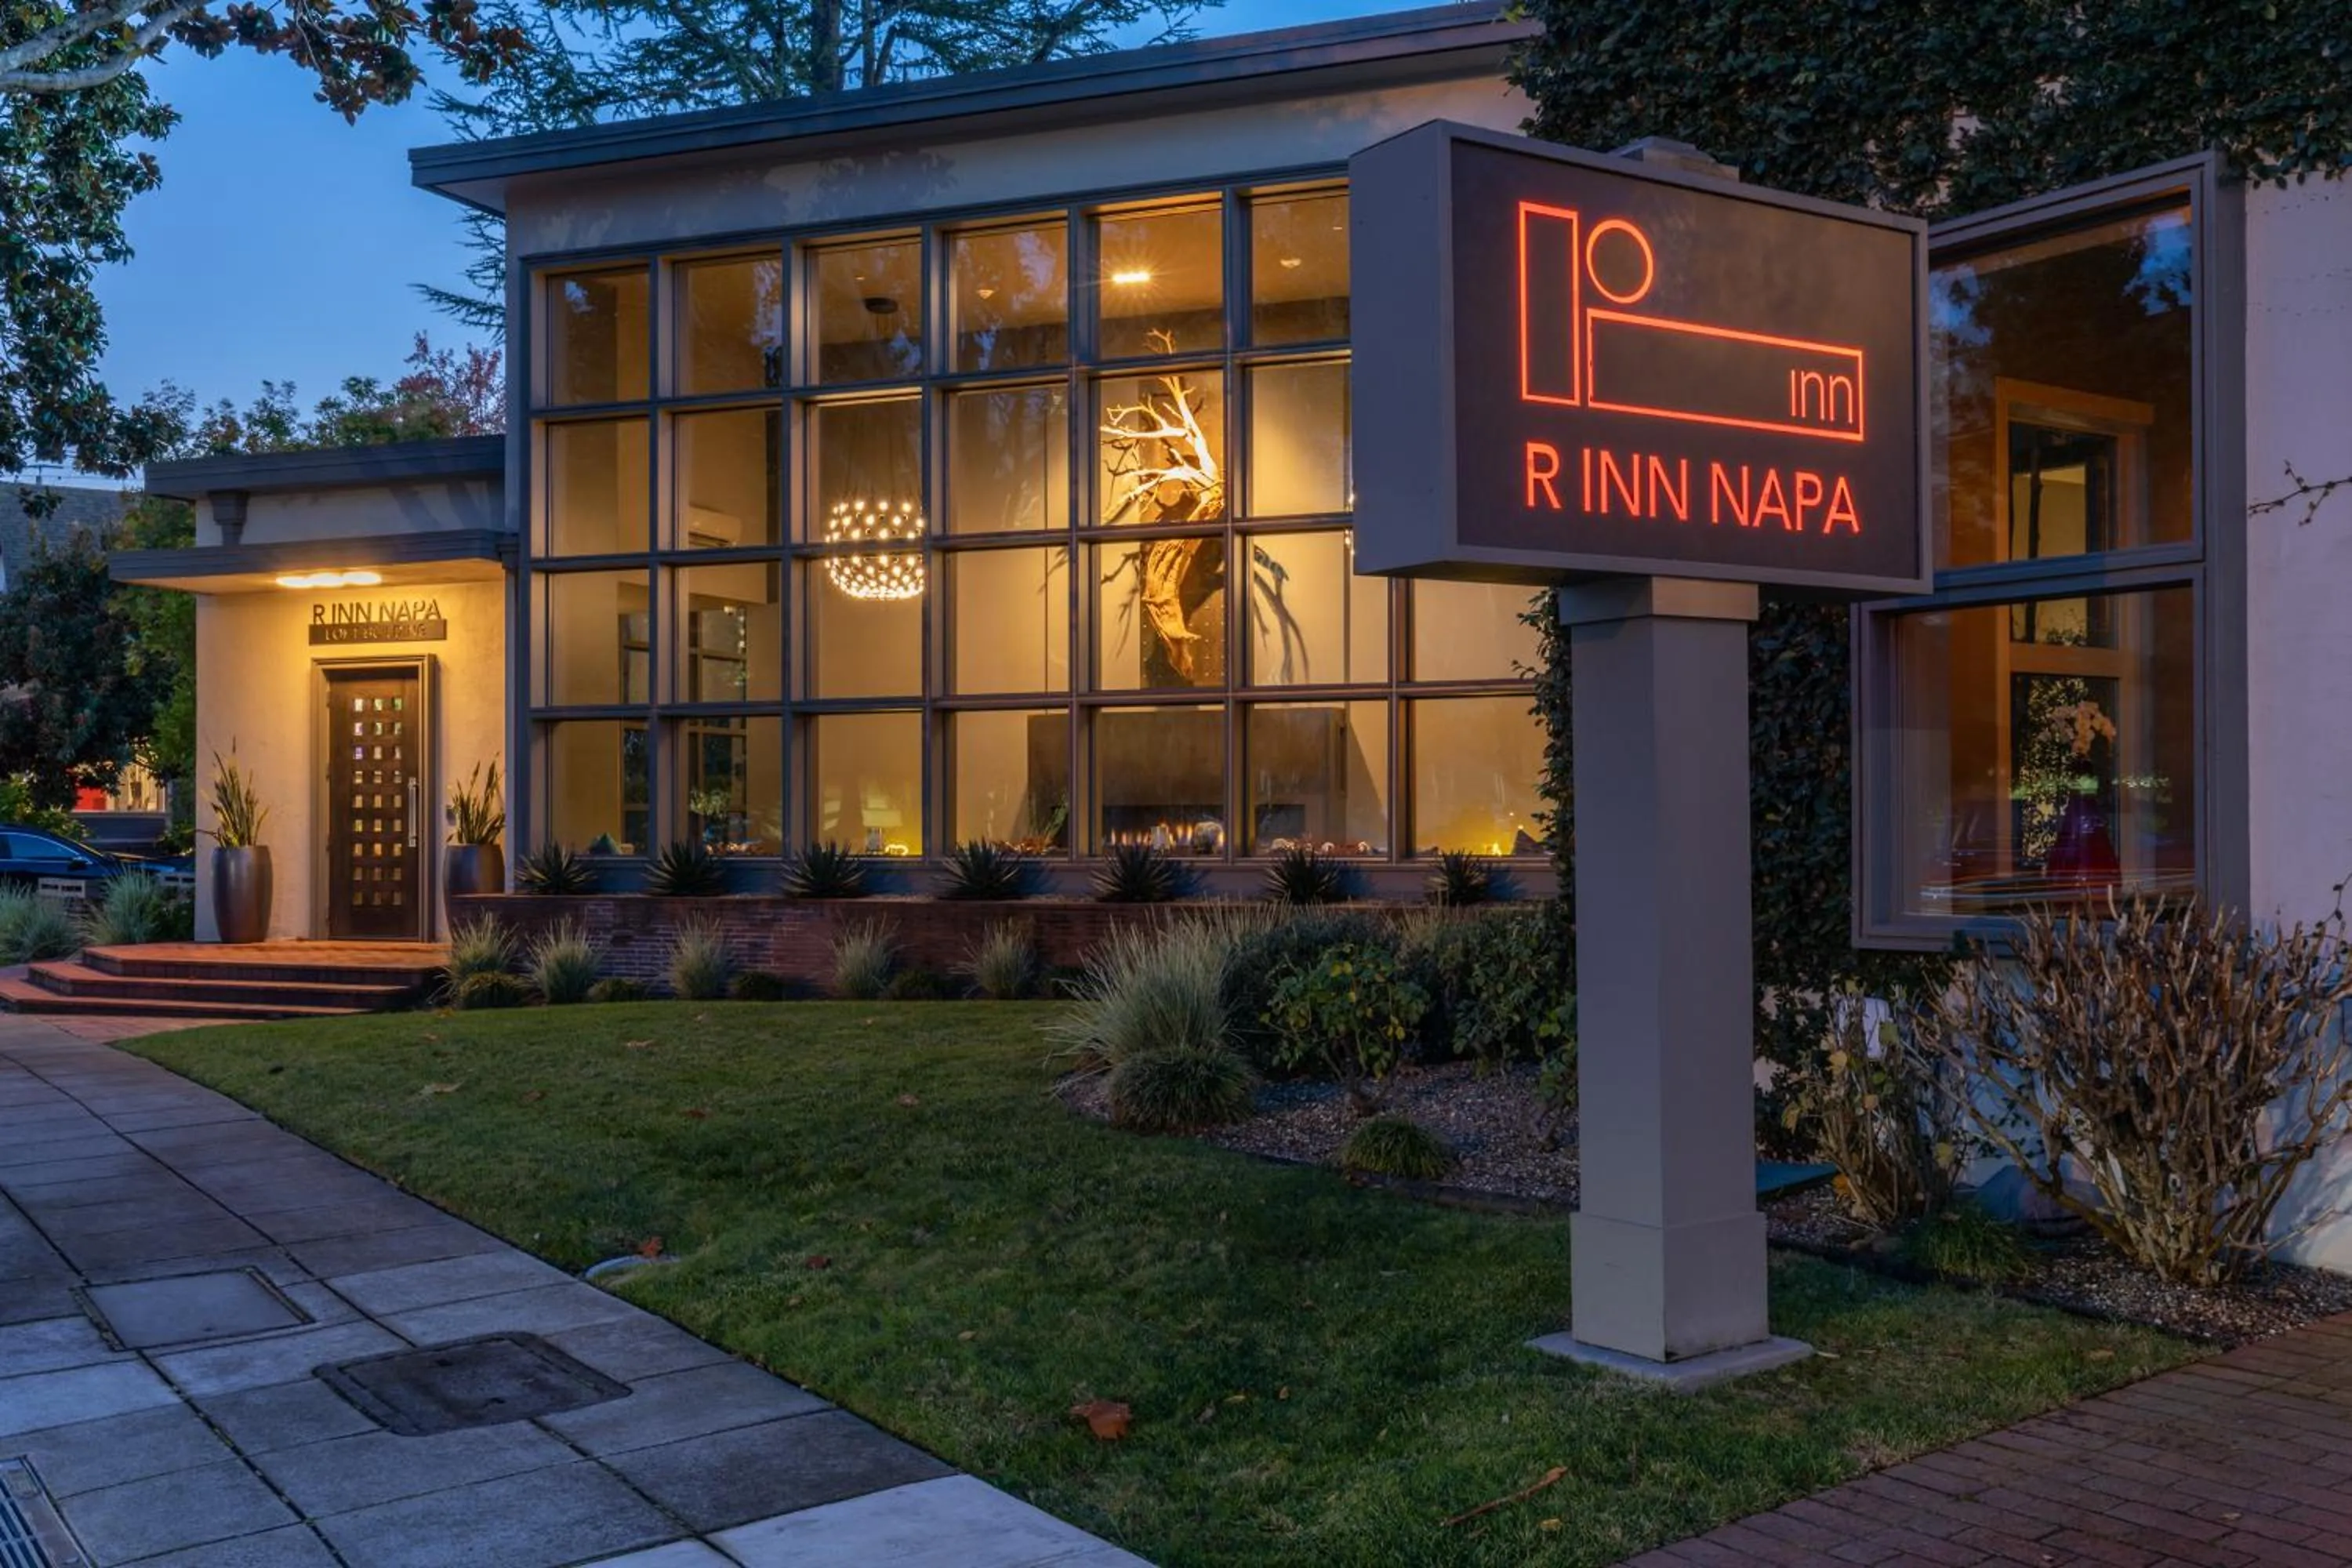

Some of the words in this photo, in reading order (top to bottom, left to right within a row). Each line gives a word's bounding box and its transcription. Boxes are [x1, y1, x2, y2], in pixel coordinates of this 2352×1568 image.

[1526, 441, 1561, 509] R
[1583, 448, 1688, 521] INN
[1711, 463, 1860, 535] NAPA
[314, 604, 325, 625] R
[332, 602, 371, 623] INN
[379, 599, 441, 622] NAPA
